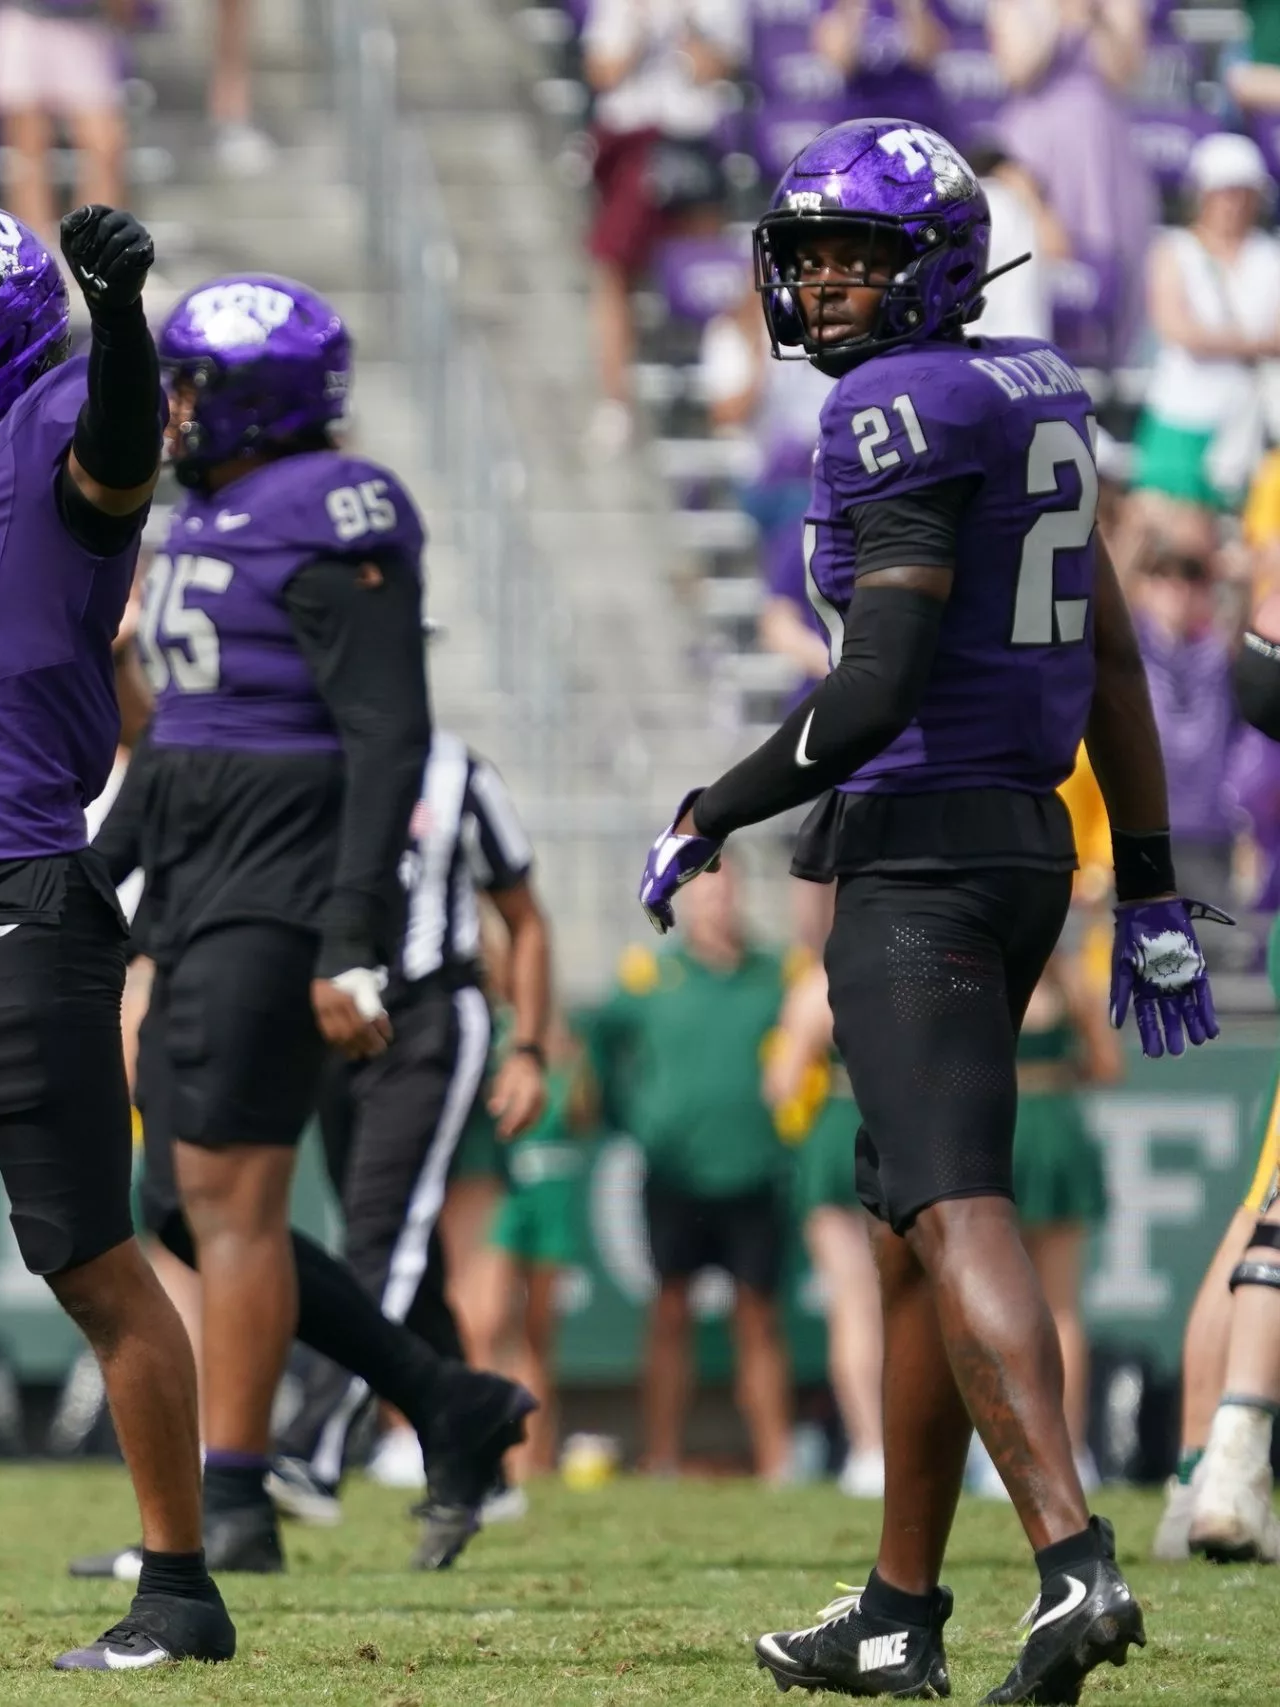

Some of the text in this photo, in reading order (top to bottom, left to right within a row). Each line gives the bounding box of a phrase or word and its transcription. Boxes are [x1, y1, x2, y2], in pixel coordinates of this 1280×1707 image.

[851, 393, 929, 476] 21
[324, 478, 398, 541] 95
[1010, 414, 1100, 644] 2
[858, 1631, 909, 1673] NIKE
